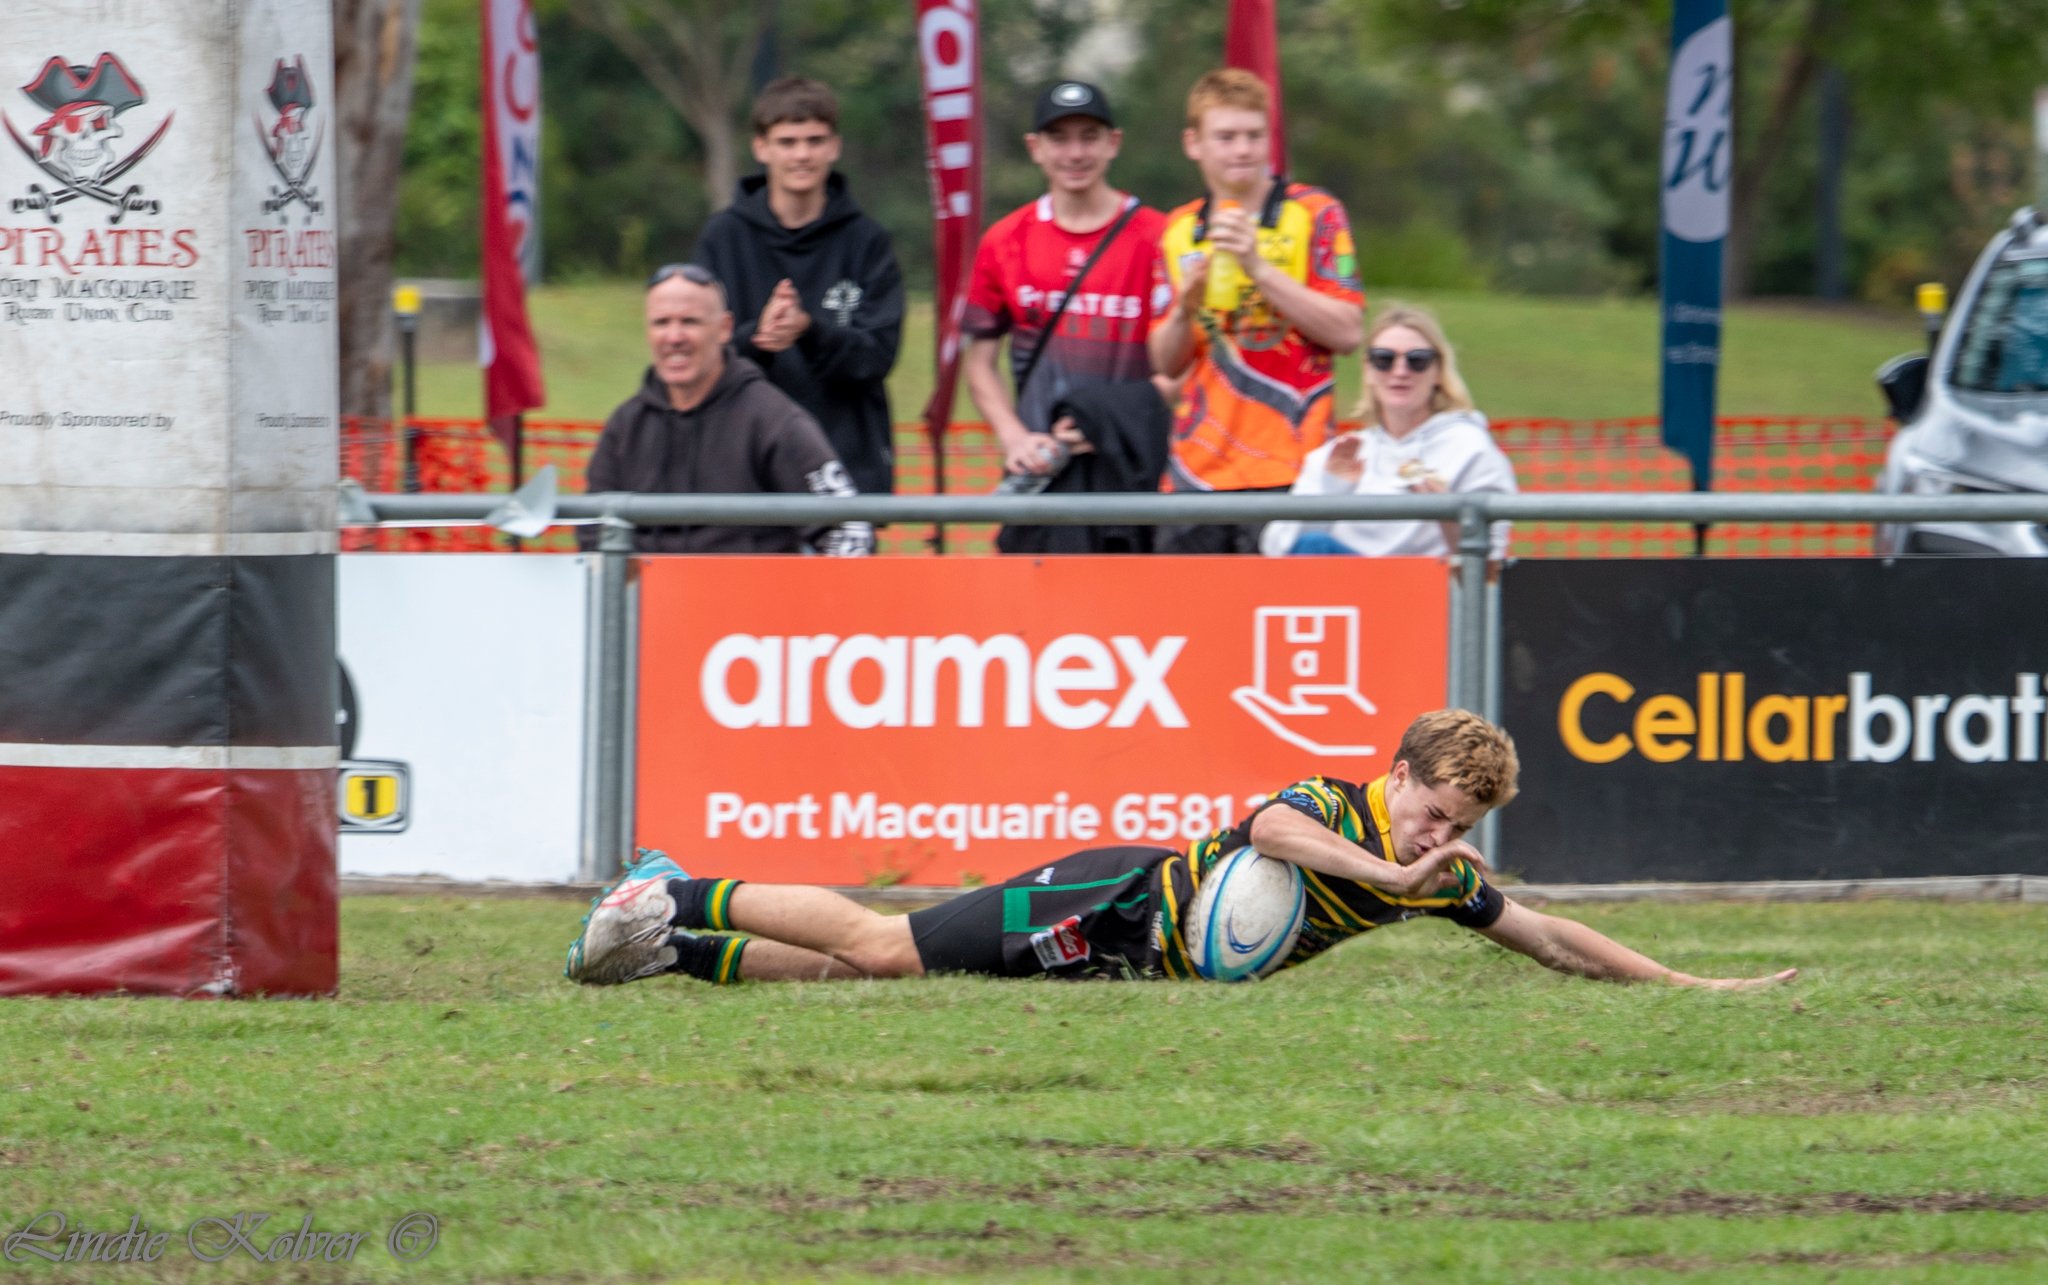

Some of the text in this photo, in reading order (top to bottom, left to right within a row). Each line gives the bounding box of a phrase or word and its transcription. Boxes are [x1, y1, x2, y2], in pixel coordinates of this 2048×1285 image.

[50, 277, 200, 303] MACQUARIE
[58, 410, 149, 430] Sponsored
[699, 632, 1190, 731] aramex
[1557, 671, 2048, 764] Cellarbrat
[361, 779, 378, 815] 1
[706, 791, 1234, 852] Port Macquarie 6581
